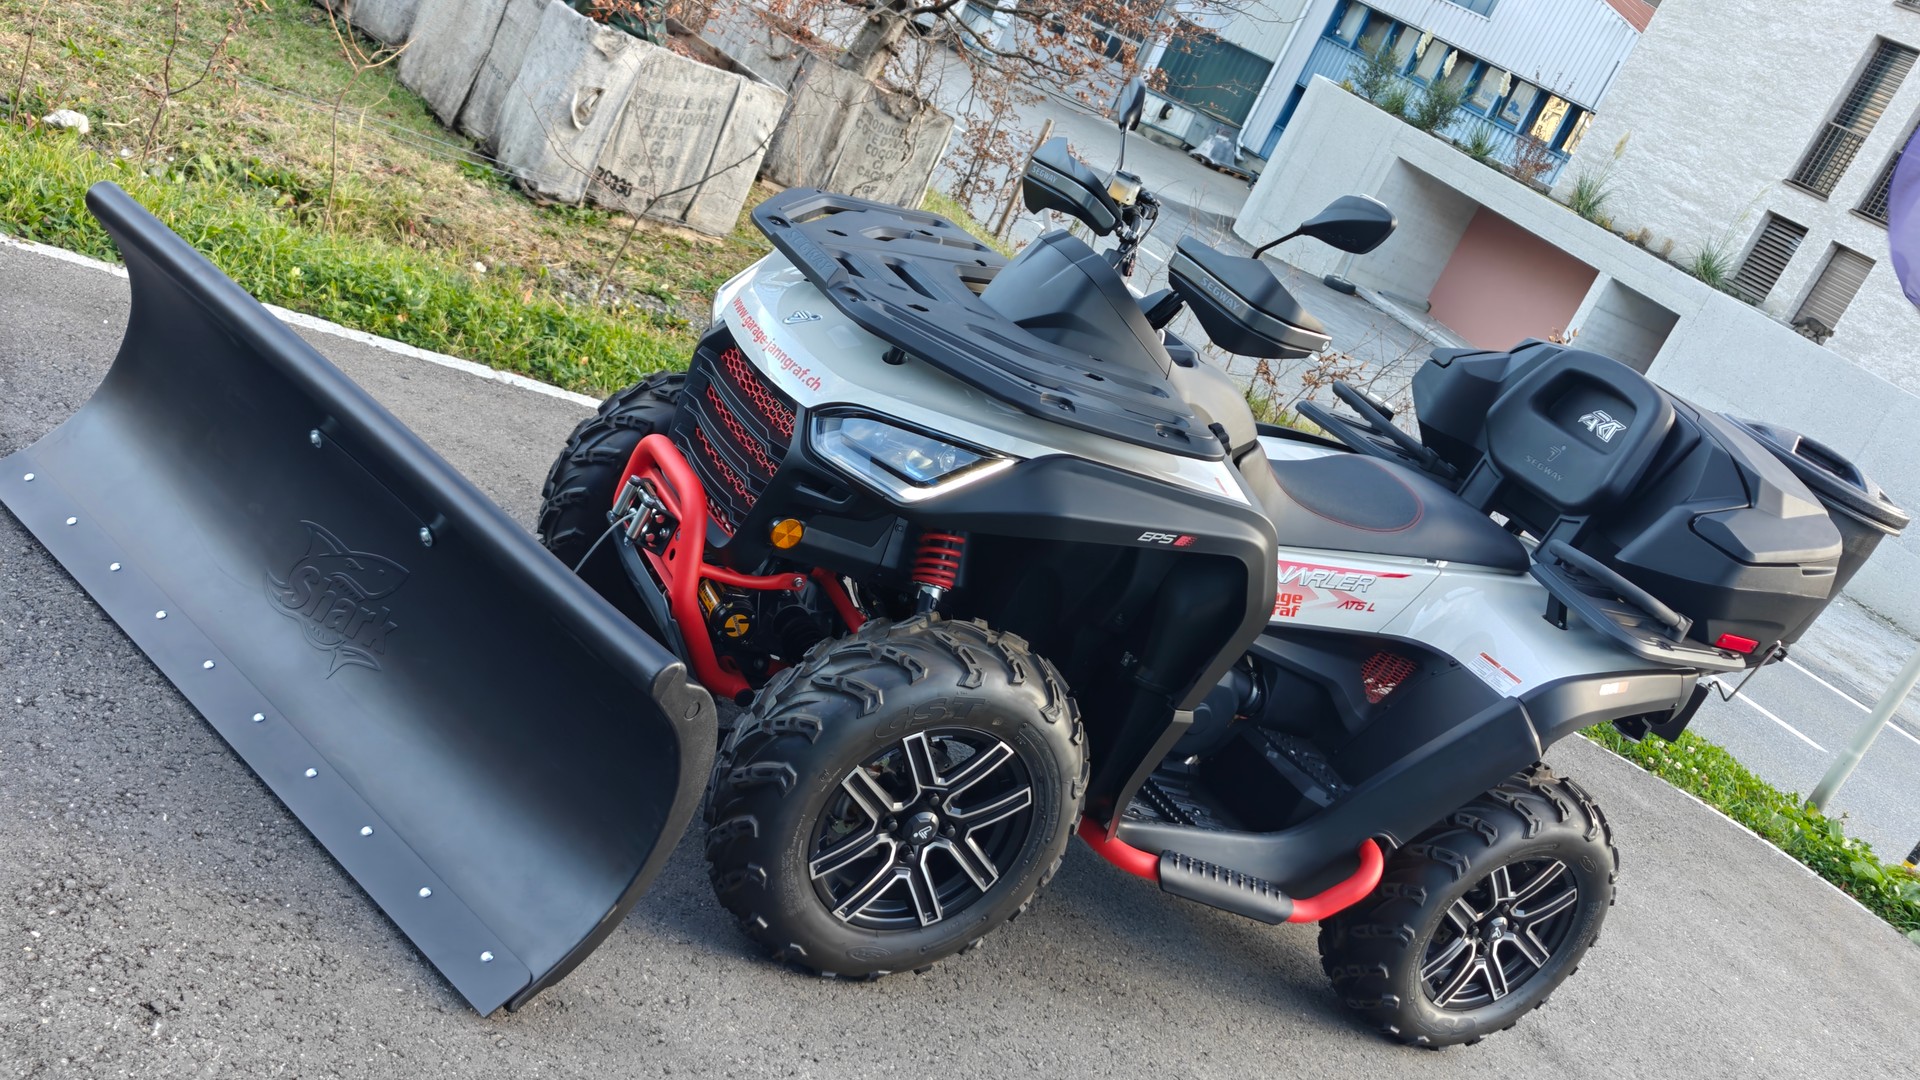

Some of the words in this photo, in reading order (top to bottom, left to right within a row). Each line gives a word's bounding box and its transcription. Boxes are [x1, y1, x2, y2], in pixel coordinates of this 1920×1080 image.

[862, 106, 906, 140] PRODUCE
[865, 143, 899, 161] COCOA
[1031, 165, 1058, 183] SEGWAY
[1200, 275, 1241, 312] SEGWAY
[732, 296, 822, 392] www.garage-janngraf.ch
[1525, 455, 1565, 481] SEGWAY
[1136, 531, 1178, 545] EPS
[1277, 564, 1377, 593] NARLER
[1271, 605, 1300, 617] raf
